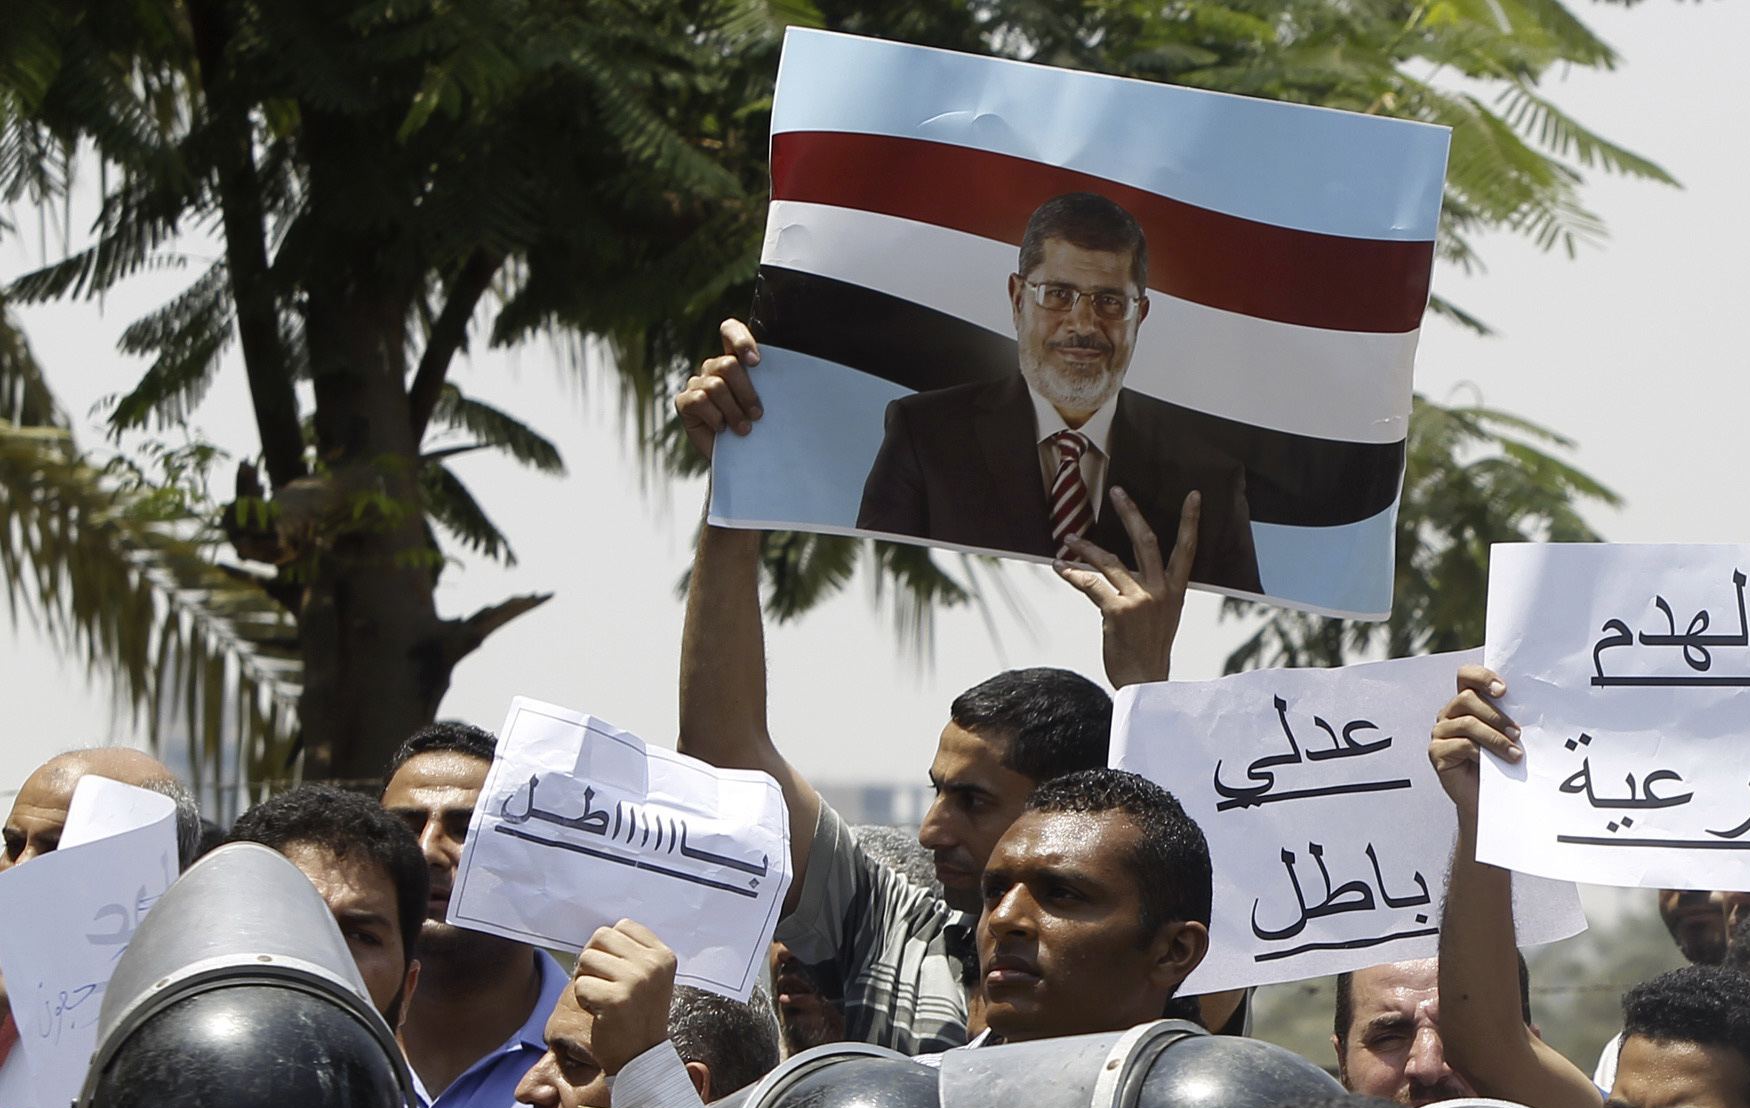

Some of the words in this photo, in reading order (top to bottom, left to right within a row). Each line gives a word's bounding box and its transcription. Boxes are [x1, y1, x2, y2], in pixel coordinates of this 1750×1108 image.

[1591, 567, 1749, 688] لهدم
[1215, 694, 1393, 808] عدلي
[1251, 841, 1431, 943] باطل
